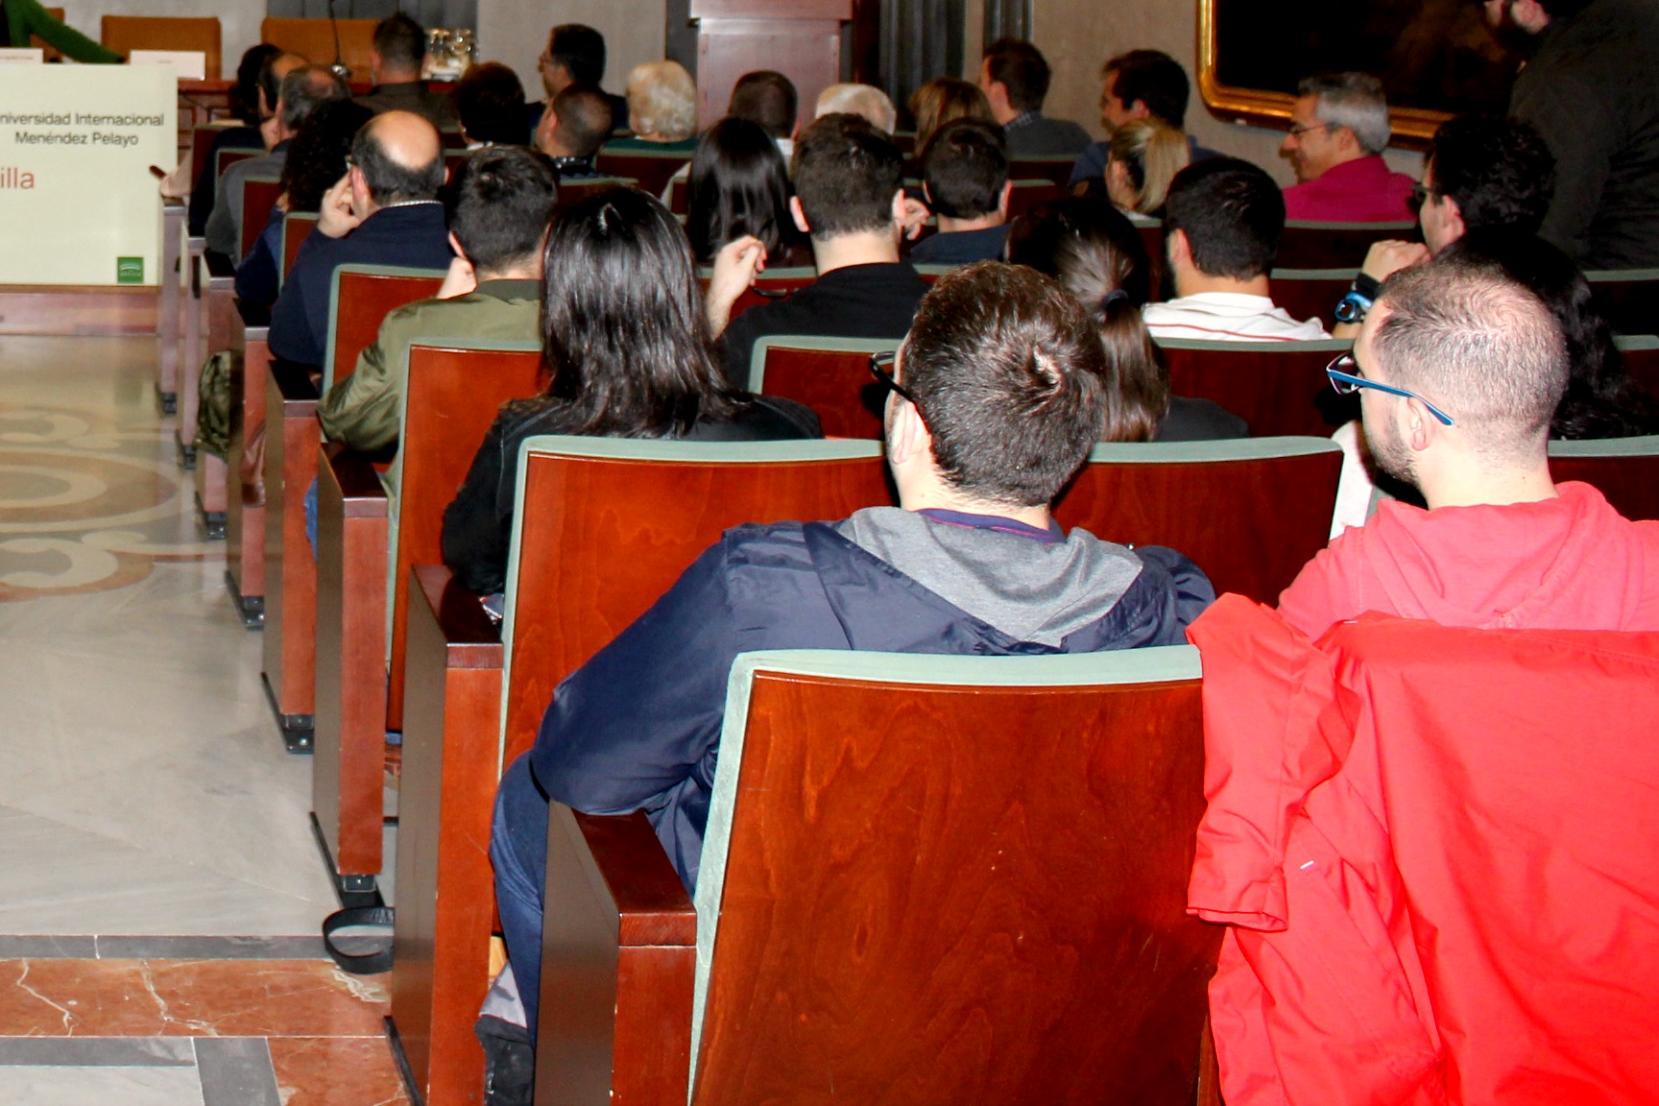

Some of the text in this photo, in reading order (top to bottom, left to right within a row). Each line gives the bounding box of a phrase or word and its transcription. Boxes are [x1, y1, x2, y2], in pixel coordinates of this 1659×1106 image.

[75, 113, 165, 127] Internacional
[15, 131, 139, 148] Menéndez Pelayo
